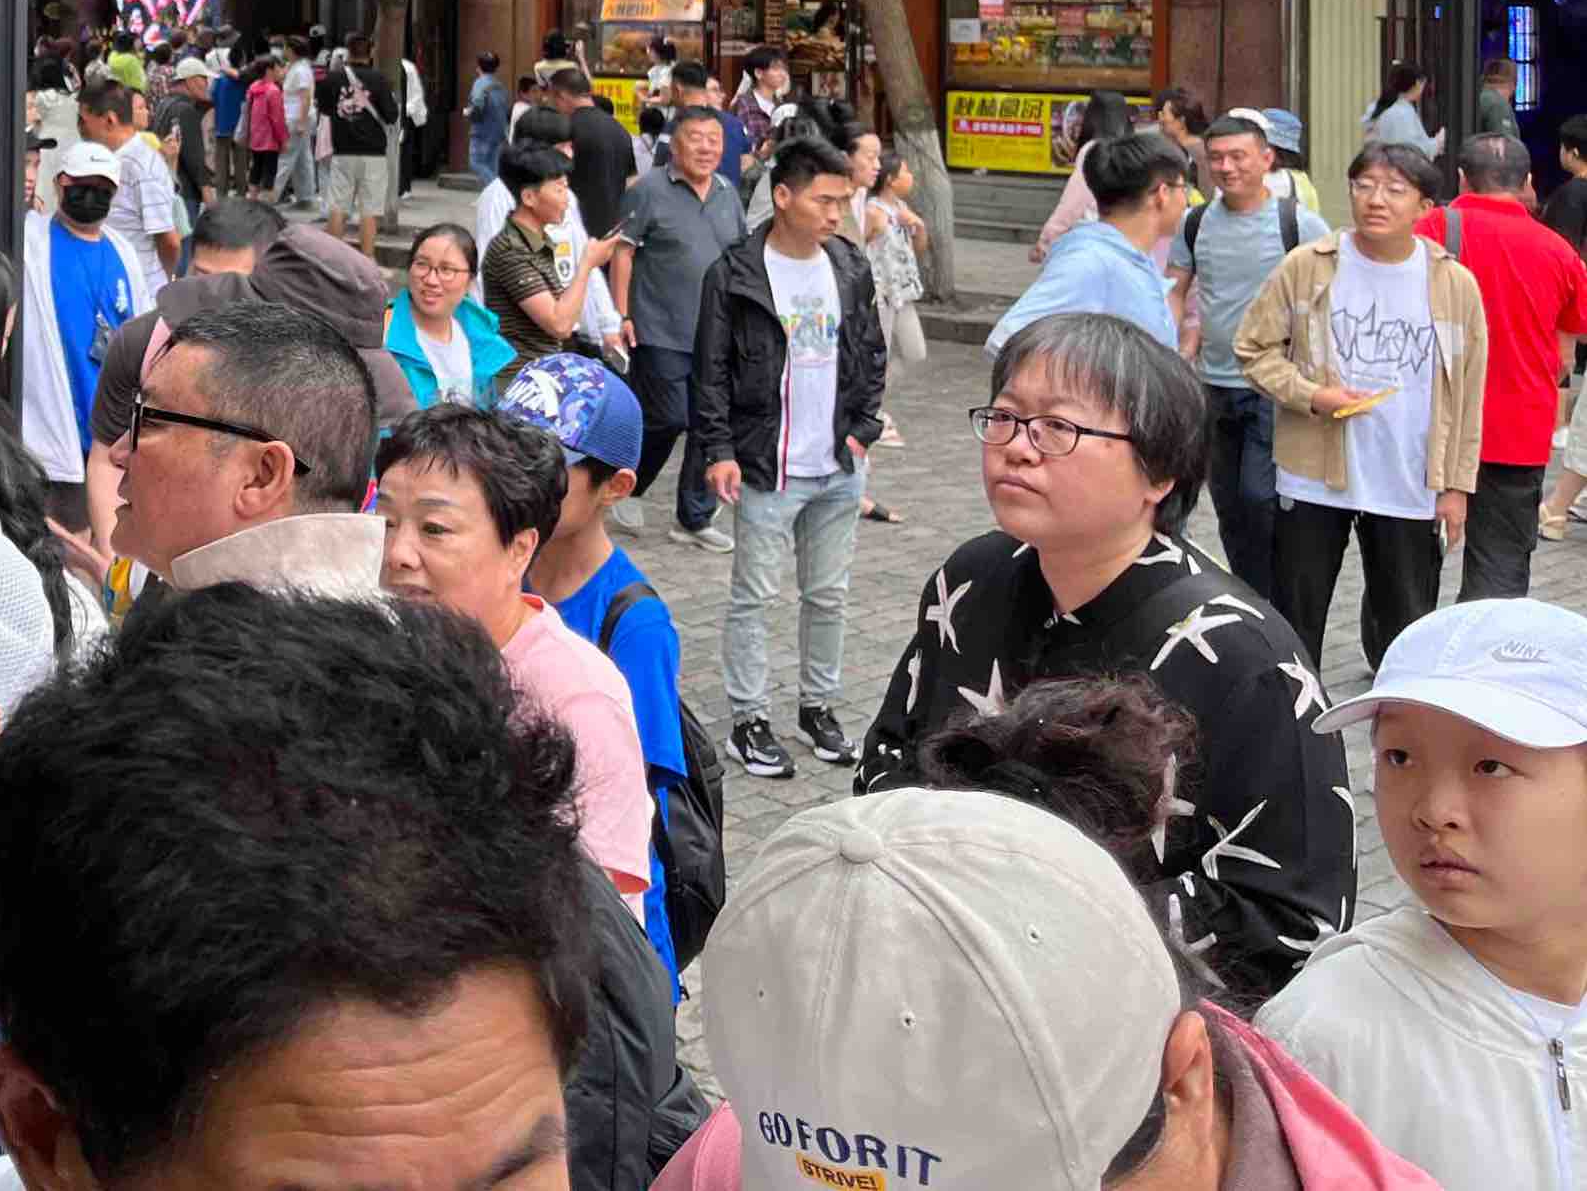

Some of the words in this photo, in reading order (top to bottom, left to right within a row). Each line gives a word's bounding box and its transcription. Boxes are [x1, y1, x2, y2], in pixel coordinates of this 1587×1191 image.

[758, 1111, 793, 1147] GO
[796, 1117, 888, 1169] FOR
[897, 1144, 942, 1186] IT
[801, 1159, 878, 1191] STRIVE!
